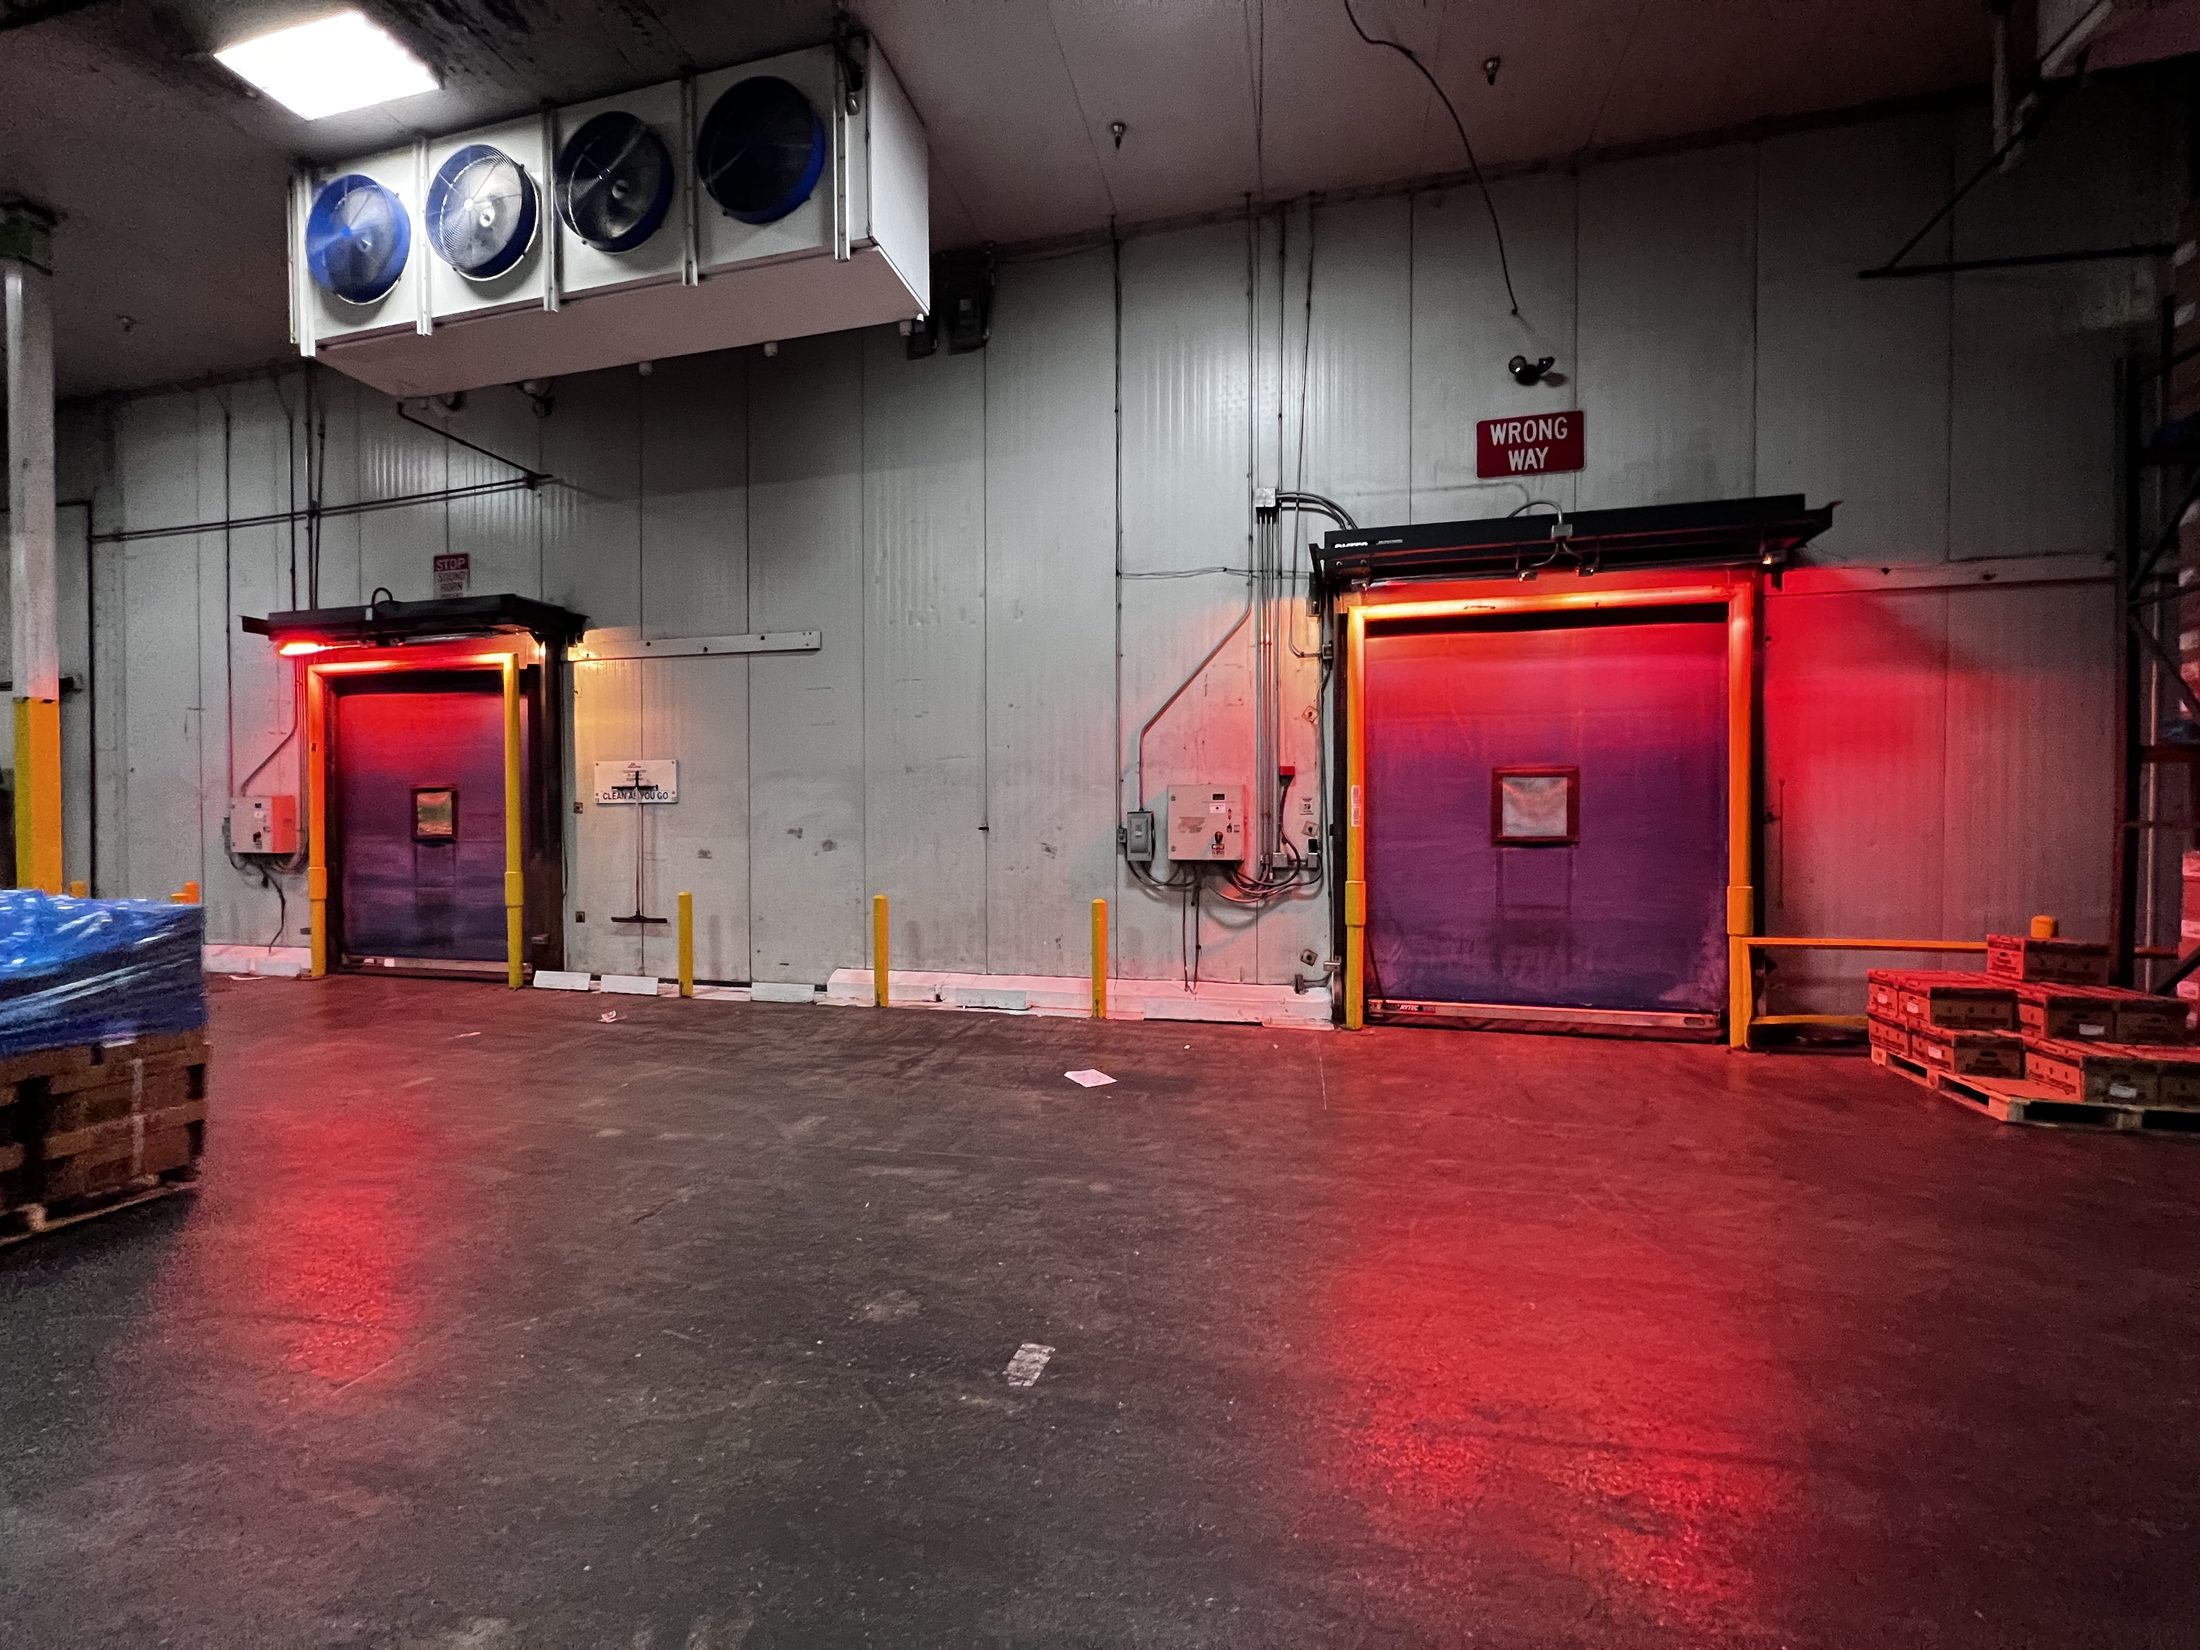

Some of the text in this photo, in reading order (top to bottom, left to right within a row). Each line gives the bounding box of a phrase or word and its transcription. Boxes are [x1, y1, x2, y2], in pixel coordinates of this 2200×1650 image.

[1490, 416, 1568, 446] WRONG
[1508, 446, 1549, 471] WAY
[436, 557, 465, 571] STOP
[602, 792, 627, 800] CLEAN
[640, 791, 656, 800] YOU
[656, 791, 669, 800] GO
[1399, 1004, 1419, 1012] RYTEC
